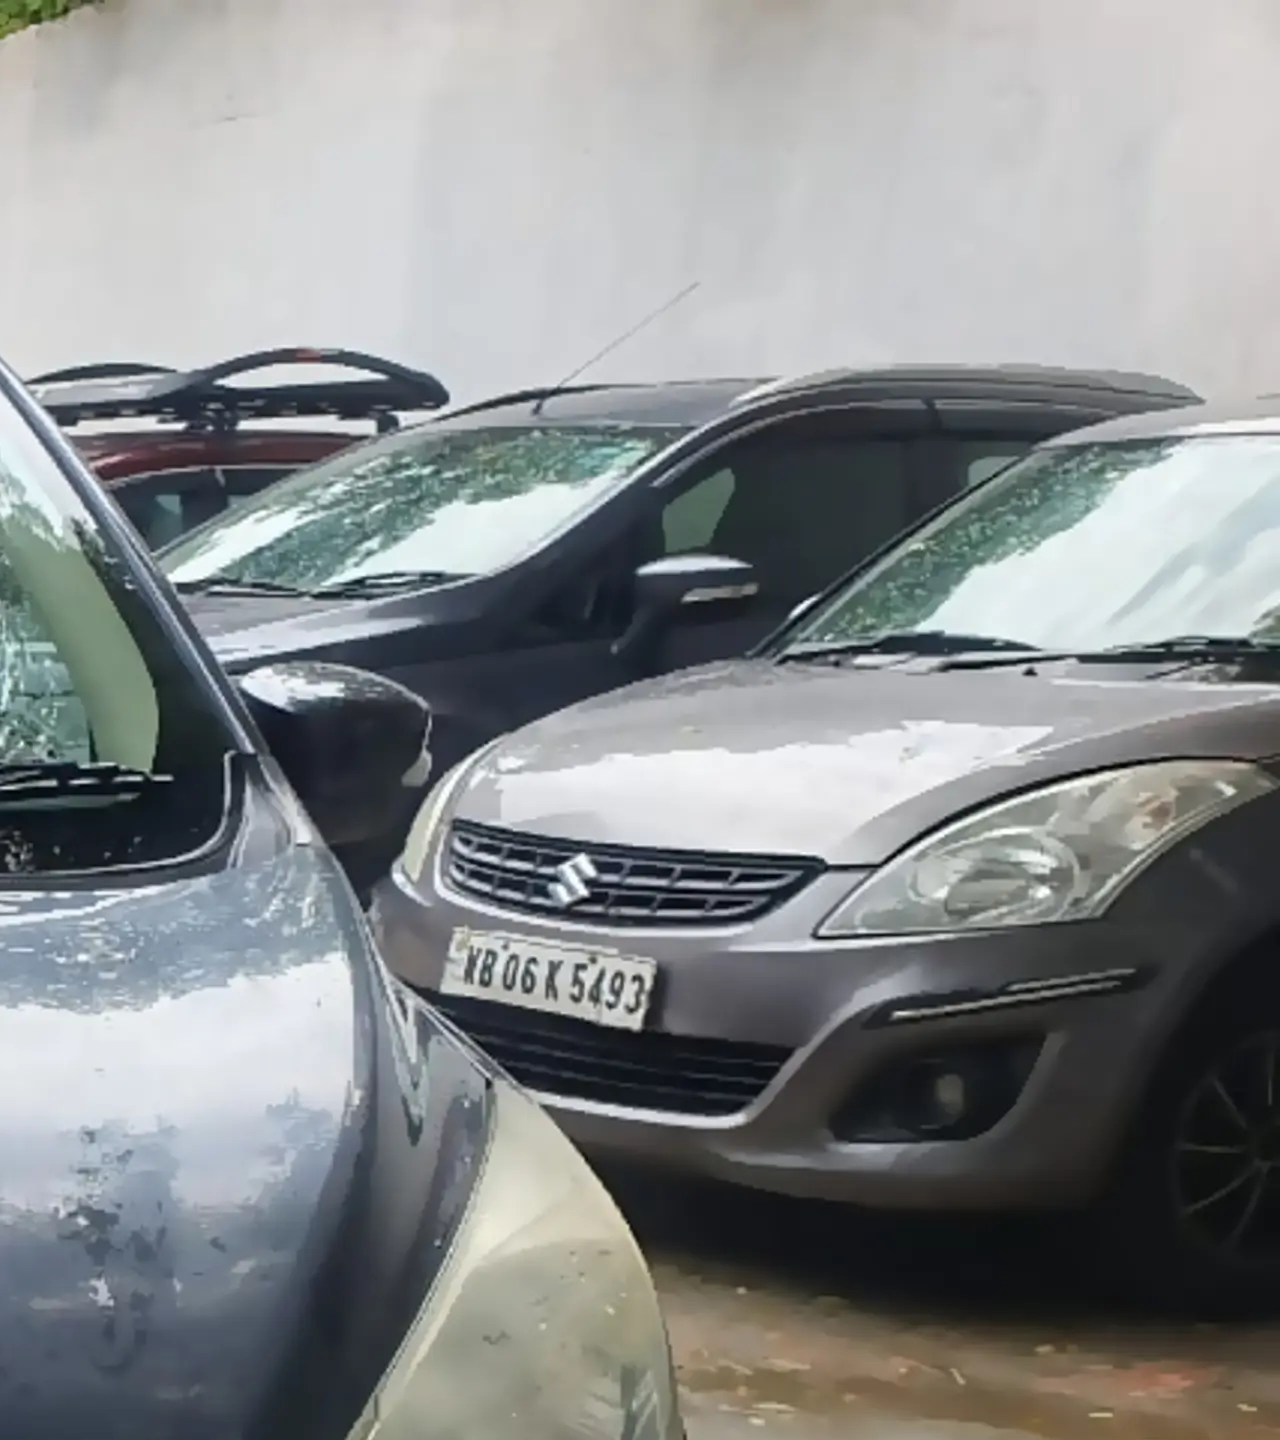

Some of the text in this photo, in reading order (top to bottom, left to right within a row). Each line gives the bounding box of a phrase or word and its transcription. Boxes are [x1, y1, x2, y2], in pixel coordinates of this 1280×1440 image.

[463, 945, 646, 1014] WB 06 K 5493
